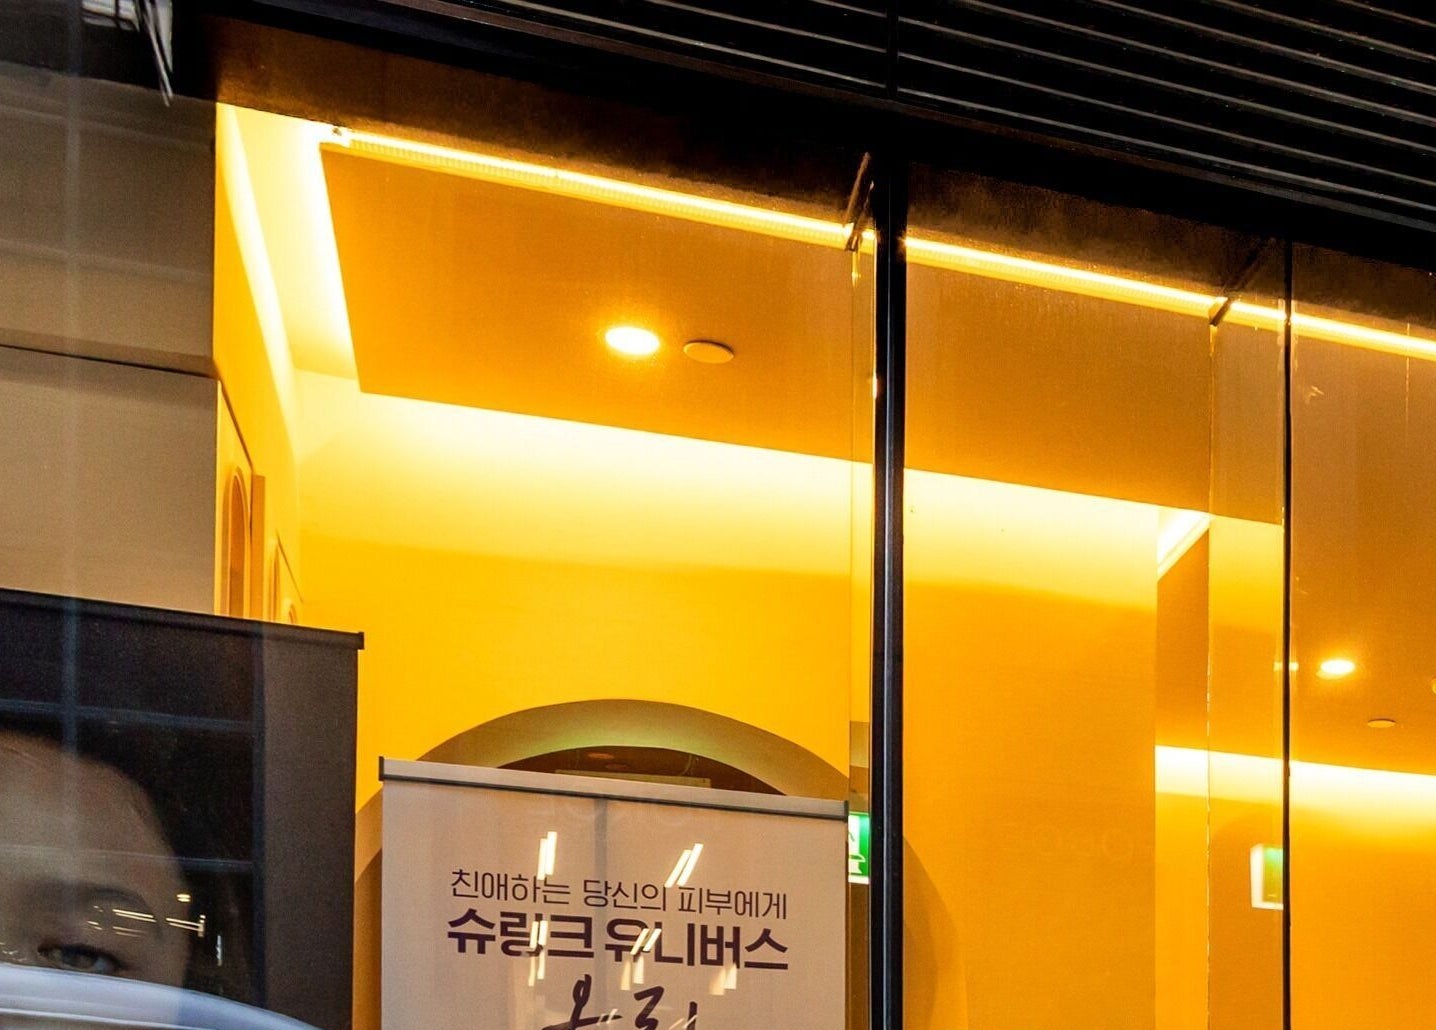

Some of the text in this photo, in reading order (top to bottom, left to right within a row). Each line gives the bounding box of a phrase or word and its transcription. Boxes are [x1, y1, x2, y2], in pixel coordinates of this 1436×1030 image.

[450, 868, 788, 920] 친애하는 당신의 피부에게
[447, 907, 789, 970] 슈링크 유니버스
